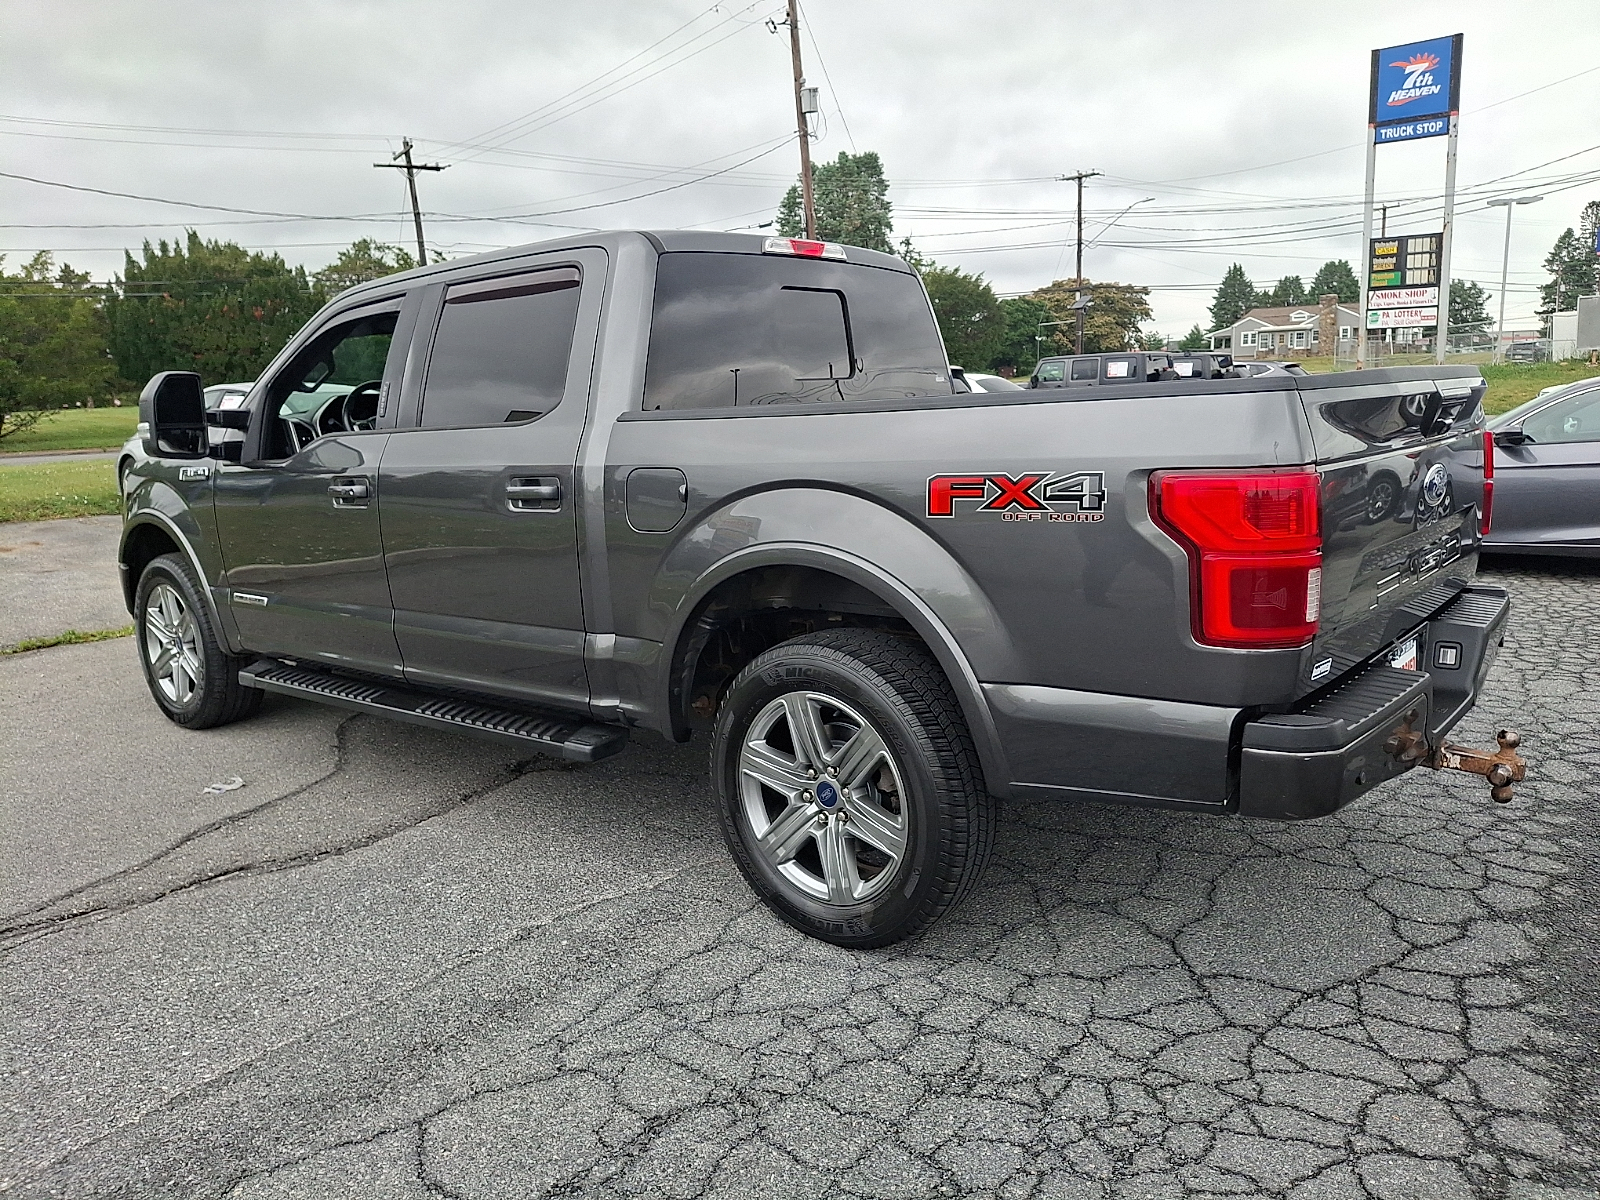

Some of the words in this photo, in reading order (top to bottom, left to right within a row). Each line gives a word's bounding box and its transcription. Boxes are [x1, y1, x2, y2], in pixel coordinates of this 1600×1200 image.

[1402, 62, 1433, 89] 7th
[1388, 84, 1441, 103] HEAVEN
[1380, 126, 1414, 139] TRUCK
[1416, 121, 1443, 134] STOP
[1375, 291, 1403, 300] SMOKE
[1404, 289, 1428, 298] SHOP
[1394, 309, 1423, 318] LOTTERY
[926, 470, 1107, 518] FX4
[1001, 511, 1041, 522] OFF
[1048, 512, 1105, 523] ROAD
